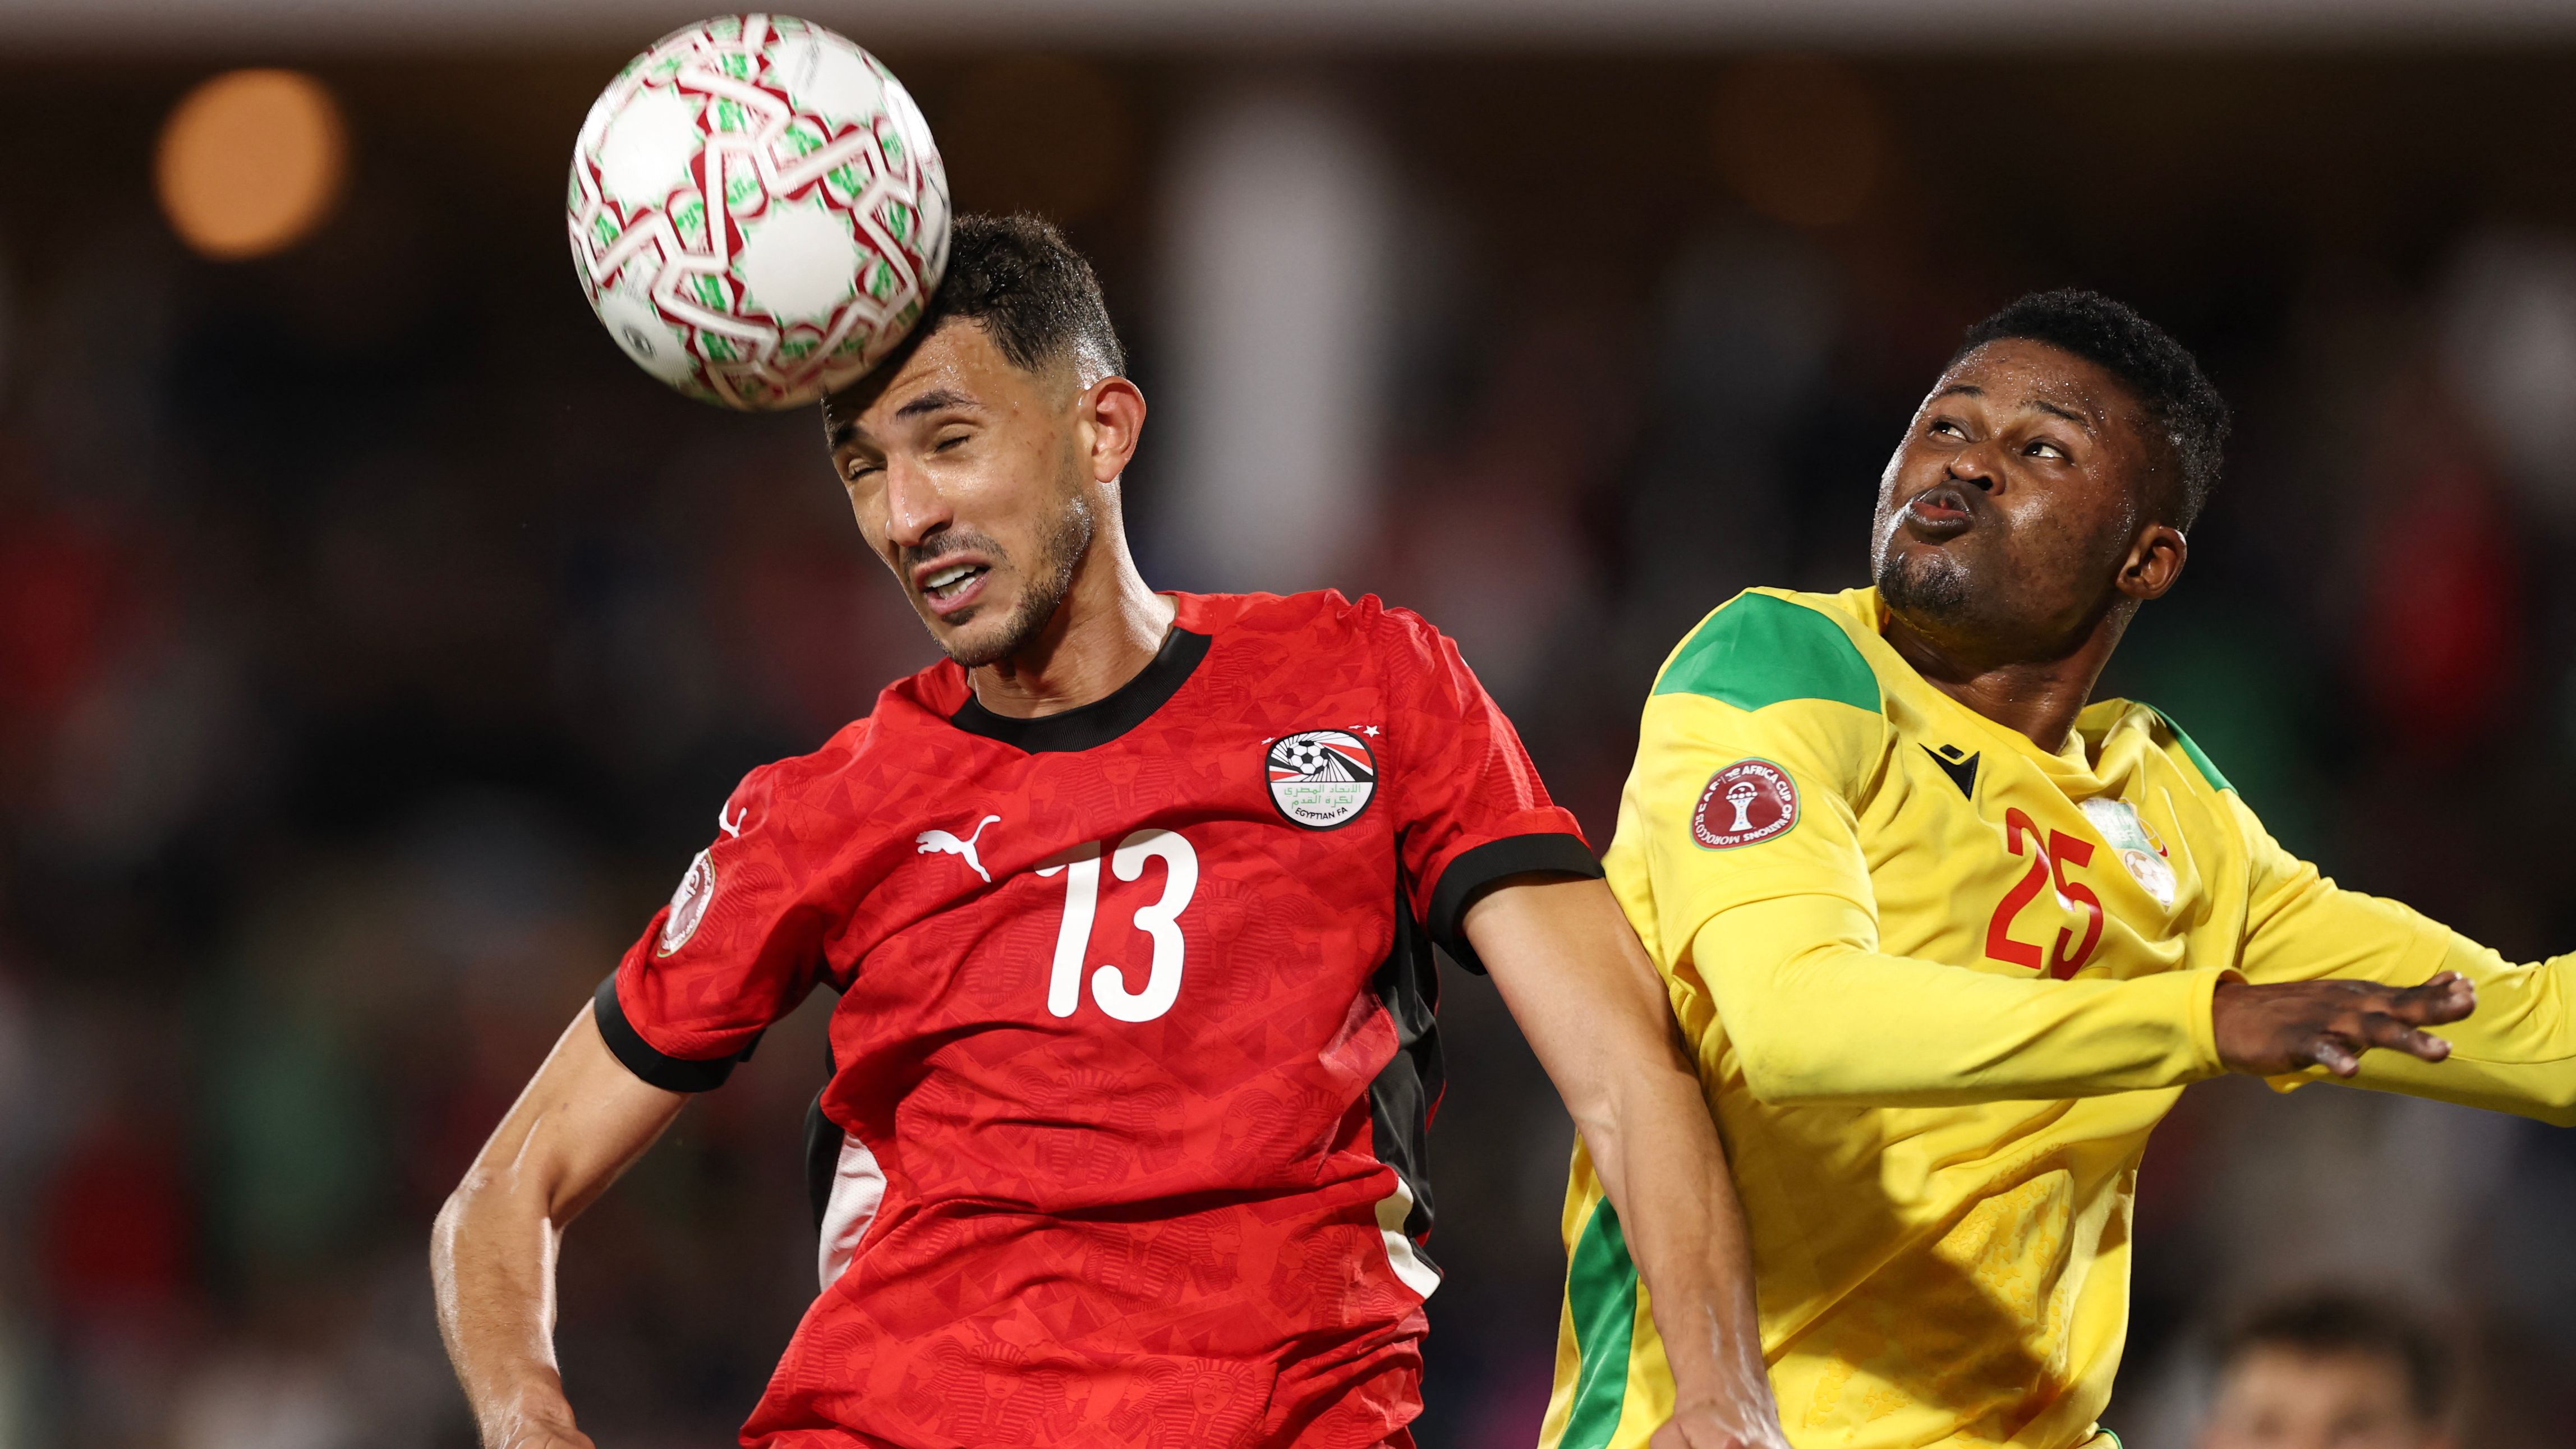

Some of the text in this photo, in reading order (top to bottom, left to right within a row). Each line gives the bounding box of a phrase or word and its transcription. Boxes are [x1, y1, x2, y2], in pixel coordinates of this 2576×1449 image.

[1295, 807, 1348, 820] EGYPTIAN FA
[1695, 825, 1740, 845] MOROCCO
[1742, 765, 1793, 841] AFRICA CUP OF NATIONS
[1034, 828, 1199, 1023] 13
[1985, 807, 2104, 981] 25
